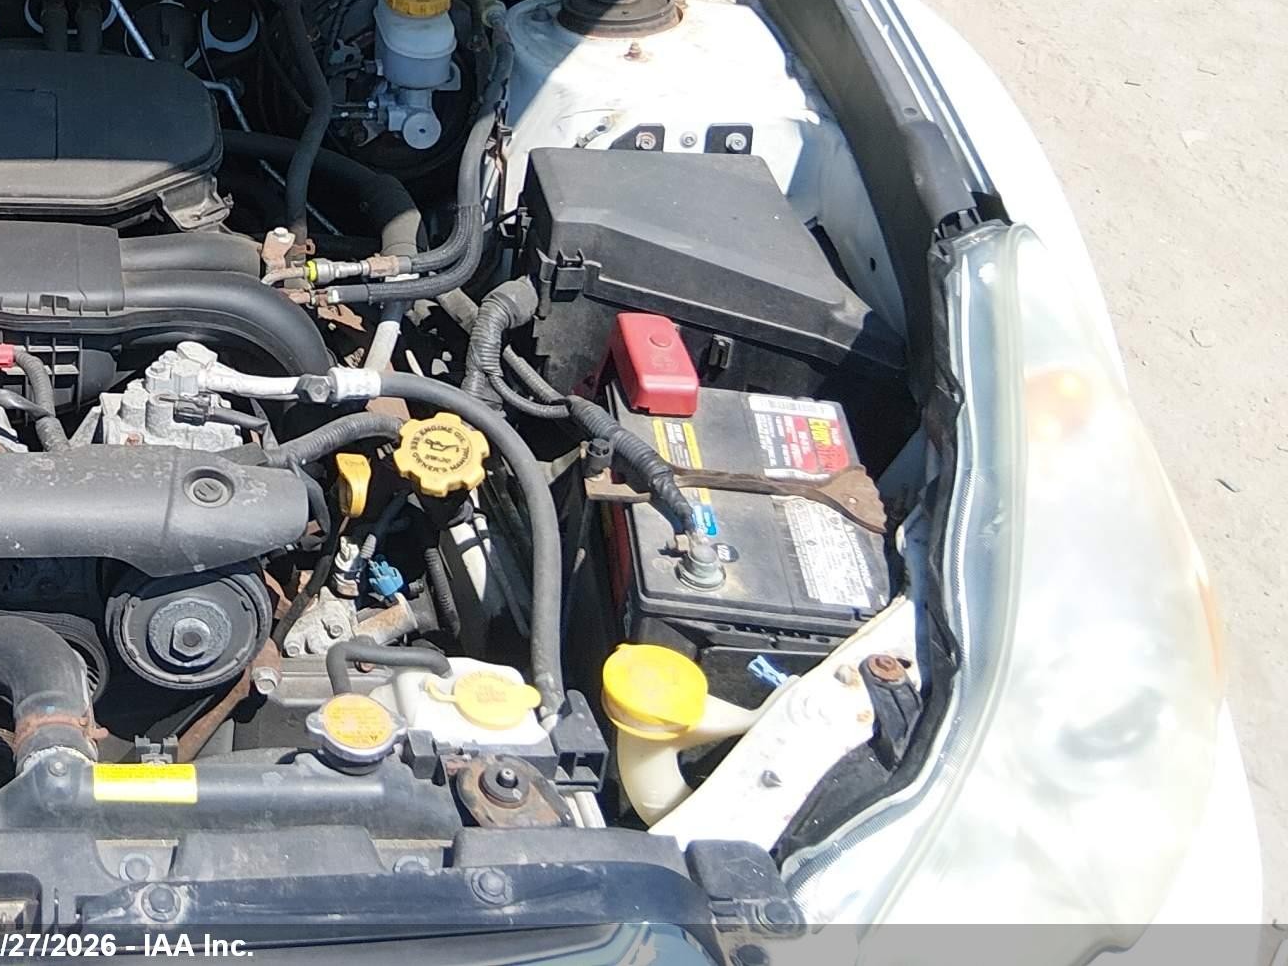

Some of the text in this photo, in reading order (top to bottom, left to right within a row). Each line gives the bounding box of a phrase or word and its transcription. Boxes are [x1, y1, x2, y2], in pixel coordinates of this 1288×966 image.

[420, 425, 466, 443] ENGINE OIL
[410, 437, 421, 450] SEE
[449, 446, 470, 472] MANUAL
